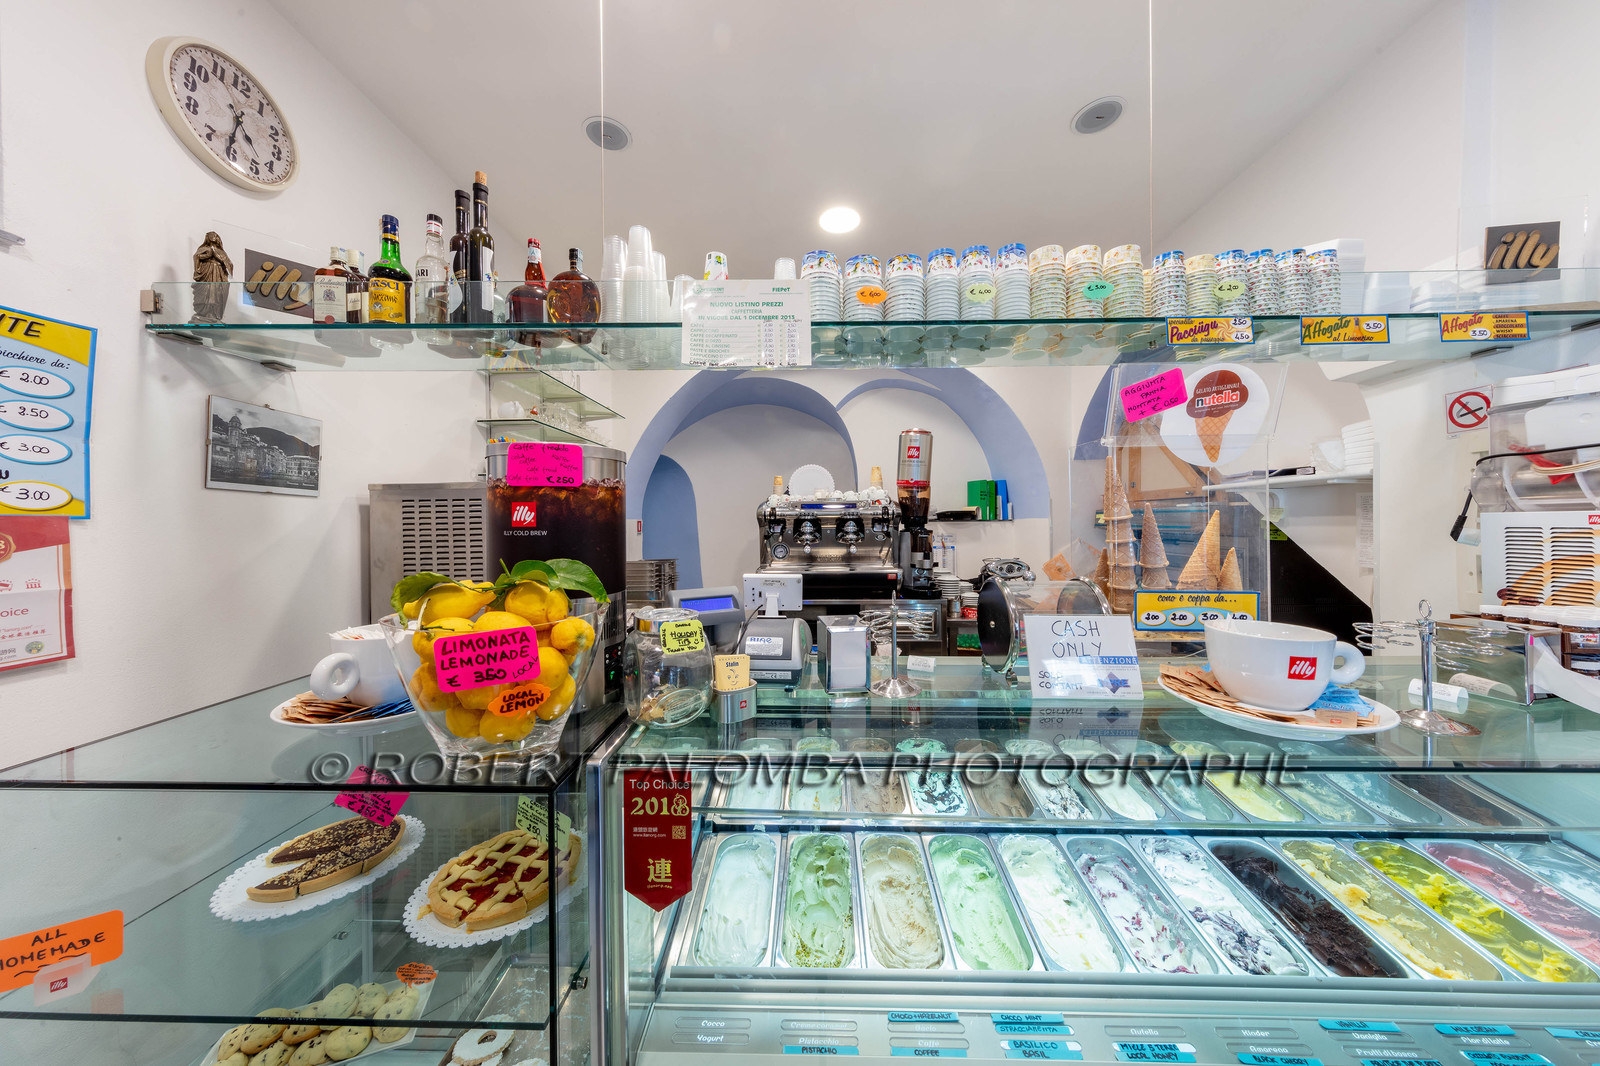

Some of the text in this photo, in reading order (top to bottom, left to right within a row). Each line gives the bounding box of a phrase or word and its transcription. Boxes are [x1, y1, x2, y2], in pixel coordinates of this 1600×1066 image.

[188, 56, 209, 83] 10
[211, 59, 226, 84] 11
[184, 72, 197, 92] 9
[231, 72, 251, 98] 12
[185, 95, 199, 116] 8
[257, 100, 265, 117] 1
[204, 123, 216, 142] 7
[269, 125, 279, 142] 2
[225, 145, 237, 162] 6
[271, 144, 282, 161] 3
[249, 158, 260, 175] 5
[264, 160, 275, 174] 4
[1487, 230, 1560, 277] illy
[246, 261, 312, 310] illy
[1302, 315, 1351, 342] Affogato
[1441, 312, 1483, 336] Affogato
[1332, 332, 1374, 341] al Limoncino
[50, 359, 71, 369] da:
[20, 372, 50, 386] 2.00
[1151, 402, 1162, 412] €
[1195, 390, 1239, 408] nutella
[18, 406, 49, 419] 2.50
[18, 443, 50, 454] 3.00
[16, 488, 50, 501] 3.00
[513, 505, 535, 525] illy
[1157, 594, 1175, 602] cono
[1187, 594, 1210, 606] coppa
[670, 630, 697, 638] HOLIDAY
[1051, 620, 1101, 637] CASH
[441, 631, 530, 656] LIMONATA
[1052, 642, 1102, 658] ONLY
[441, 645, 530, 671] LEMONADE
[513, 655, 539, 679] LOCAL
[1290, 661, 1315, 678] illy
[446, 675, 461, 688] €
[500, 693, 544, 713] LEMON
[503, 689, 537, 703] LOCAL
[629, 779, 690, 791] Top Choice
[347, 800, 357, 810] €
[647, 858, 672, 883] 連
[31, 928, 68, 947] ALL
[51, 980, 67, 991] illy
[697, 1035, 724, 1043] Yogurt
[1130, 1028, 1159, 1036] Nutella
[1352, 1032, 1388, 1041] Vaniglia
[801, 1046, 837, 1055] PISTACHIO
[1013, 1041, 1058, 1049] BASILICO
[1250, 1046, 1288, 1054] Amarena
[1022, 1050, 1050, 1058] BASIL
[1126, 1052, 1179, 1061] LOCAL HONEY
